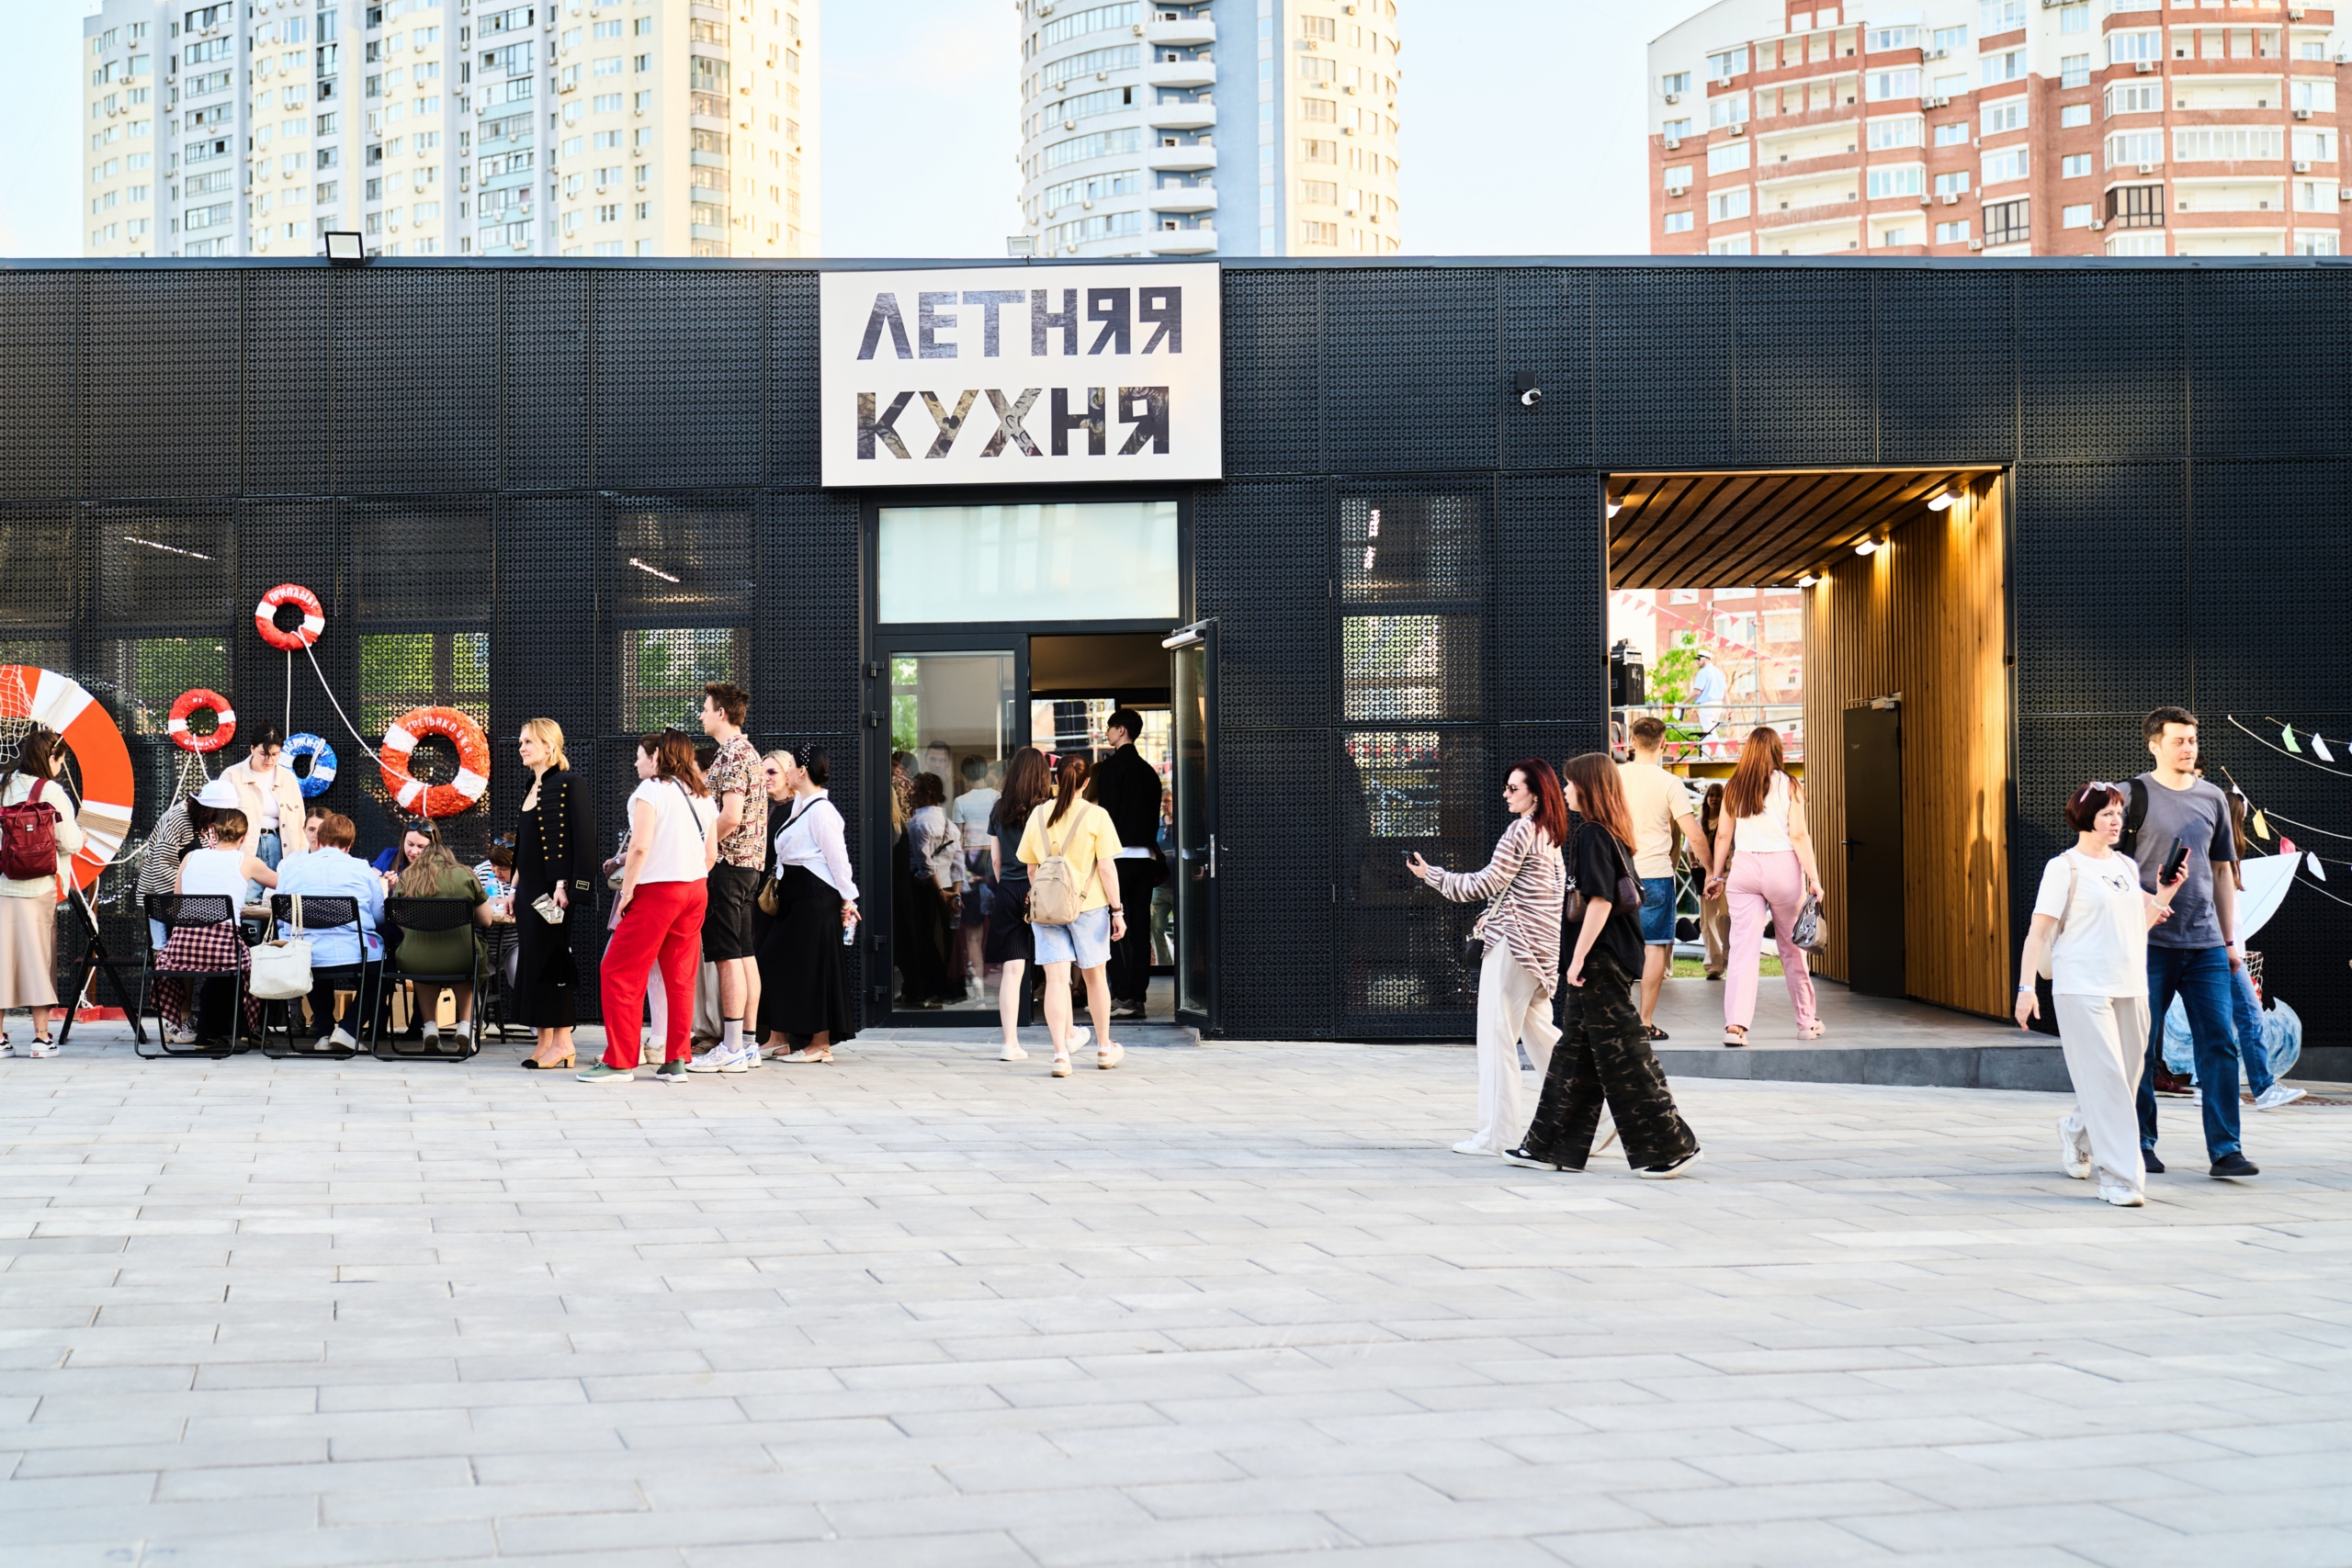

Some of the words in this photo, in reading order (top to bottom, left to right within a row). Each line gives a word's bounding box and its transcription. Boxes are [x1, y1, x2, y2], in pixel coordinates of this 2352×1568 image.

[856, 286, 1182, 360] ЛЕТНЯЯ
[857, 386, 1170, 459] КУХНЯ
[406, 716, 473, 754] ТРЕТЬЯКОВКА
